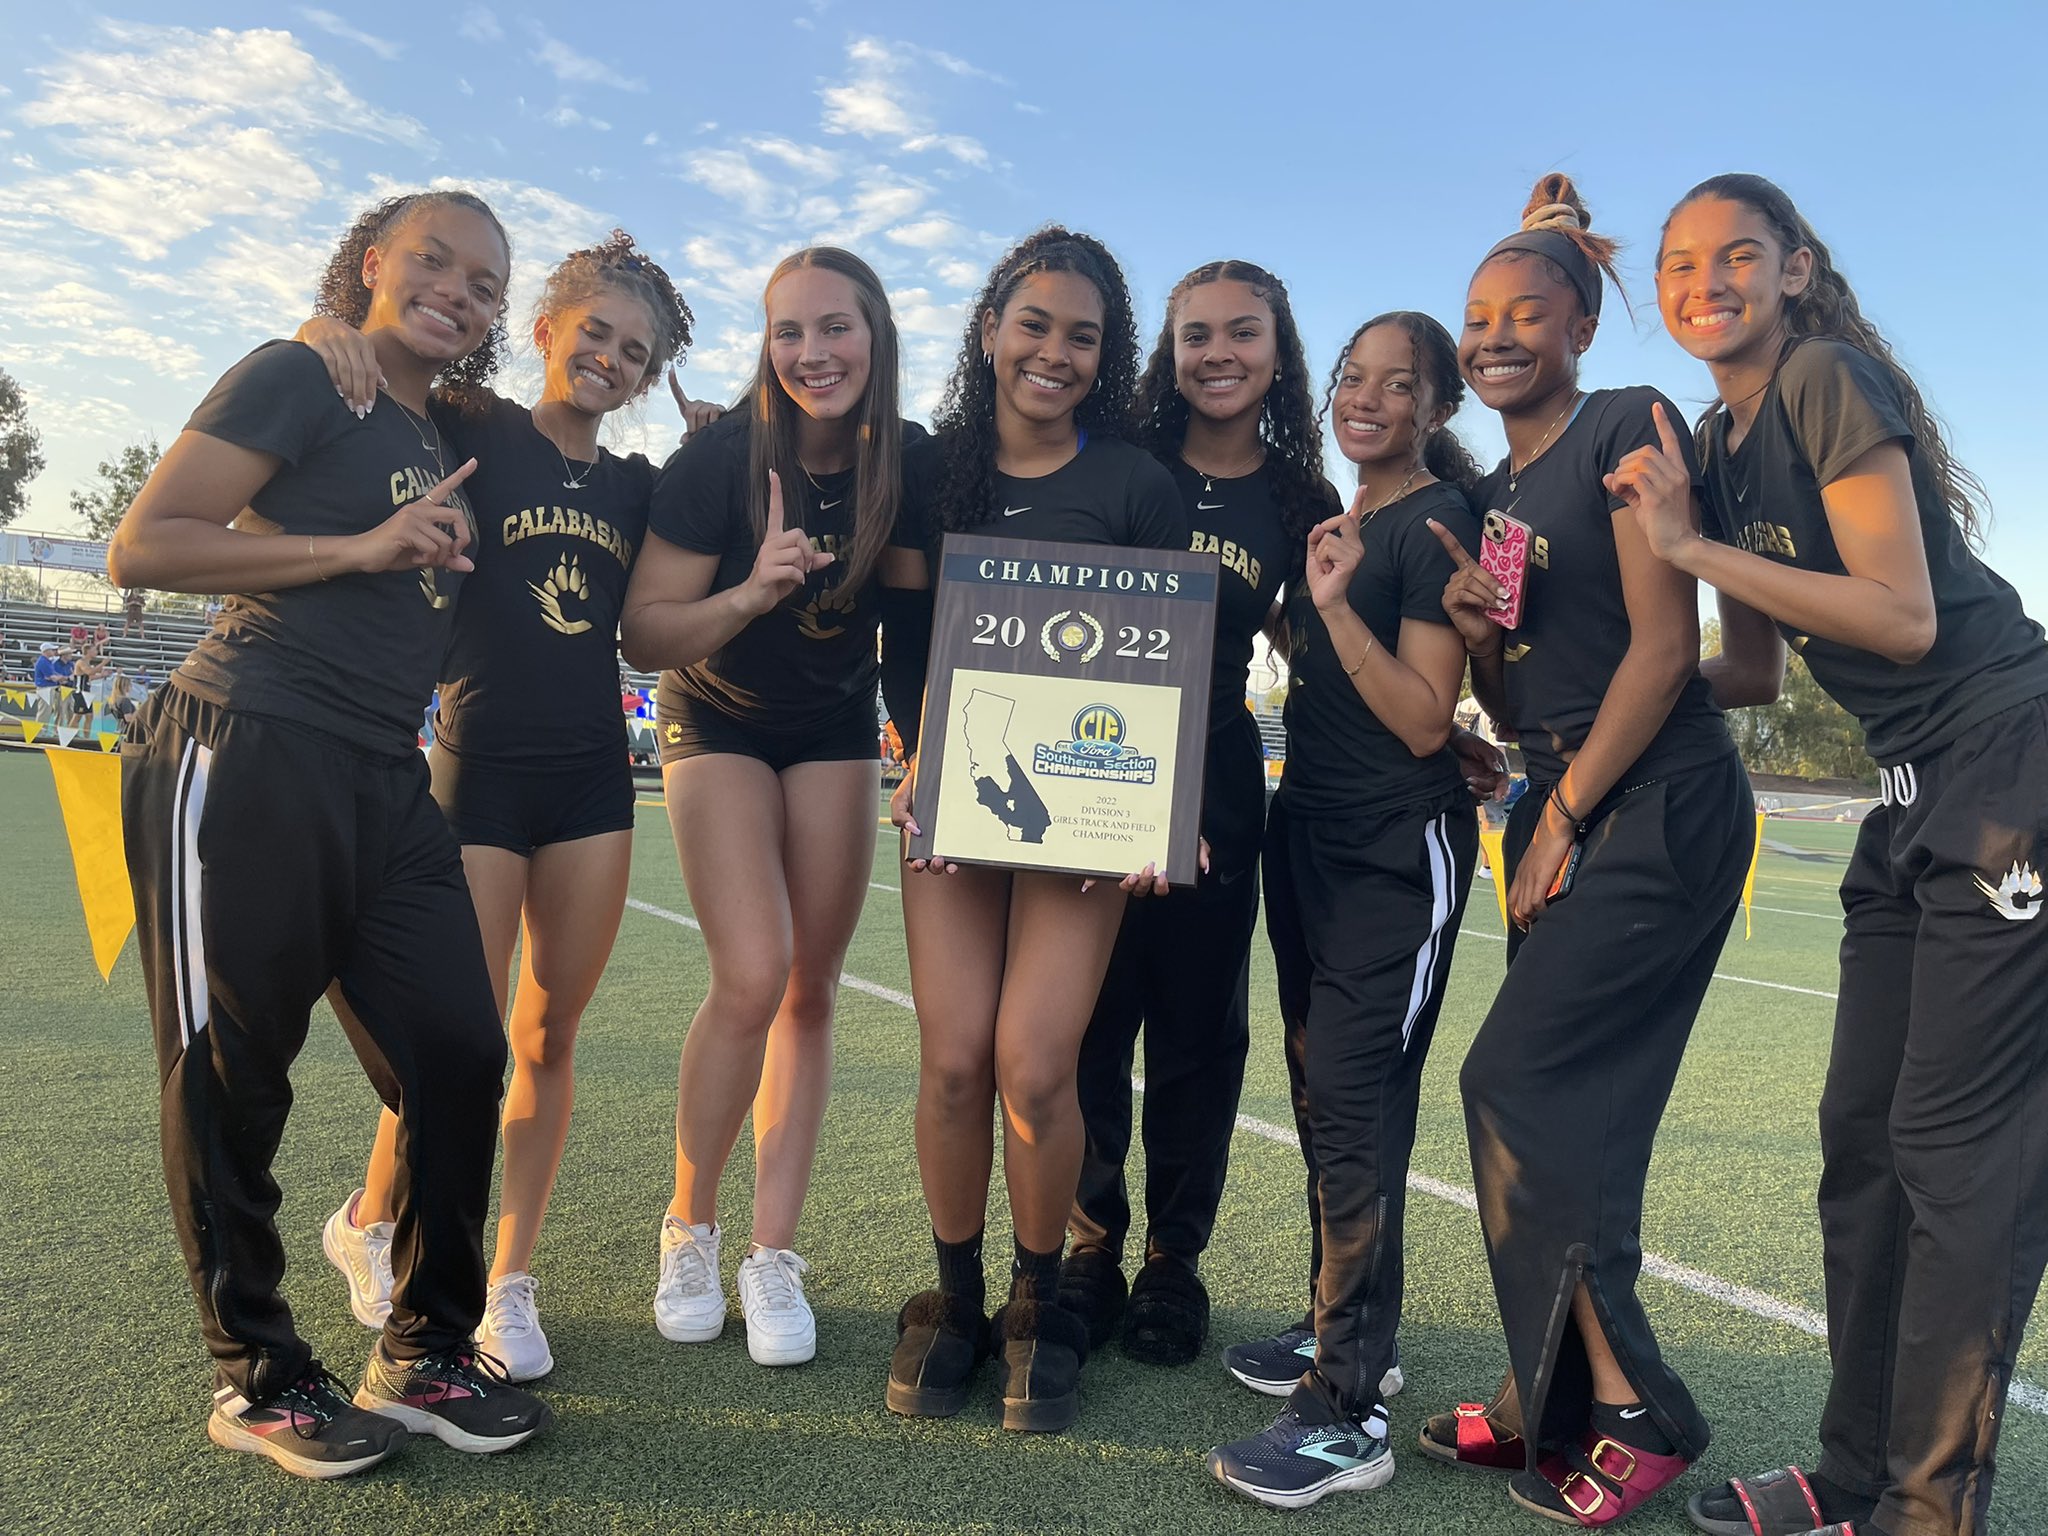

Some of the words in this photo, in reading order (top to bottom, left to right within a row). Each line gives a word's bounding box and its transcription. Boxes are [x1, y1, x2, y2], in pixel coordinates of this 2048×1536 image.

[503, 506, 632, 571] CALABASAS
[1189, 530, 1261, 590] BASAS
[979, 559, 1180, 594] CHAMPIONS
[972, 613, 1026, 648] 20
[1115, 626, 1171, 661] 22
[1079, 710, 1119, 741] CIF
[1036, 746, 1097, 769] Southern
[1103, 758, 1154, 770] Section
[1080, 741, 1114, 757] Ford
[1035, 760, 1153, 783] CHAMPIONSHIPS
[1081, 806, 1124, 817] DIVISION
[1125, 810, 1131, 818] 3
[1096, 796, 1117, 806] 2022
[1053, 815, 1078, 825] GIRLS
[1080, 818, 1109, 829] TRACK
[1110, 821, 1129, 830] AND
[1131, 823, 1156, 833] FIELD
[1072, 829, 1134, 843] CHAMPIONS
